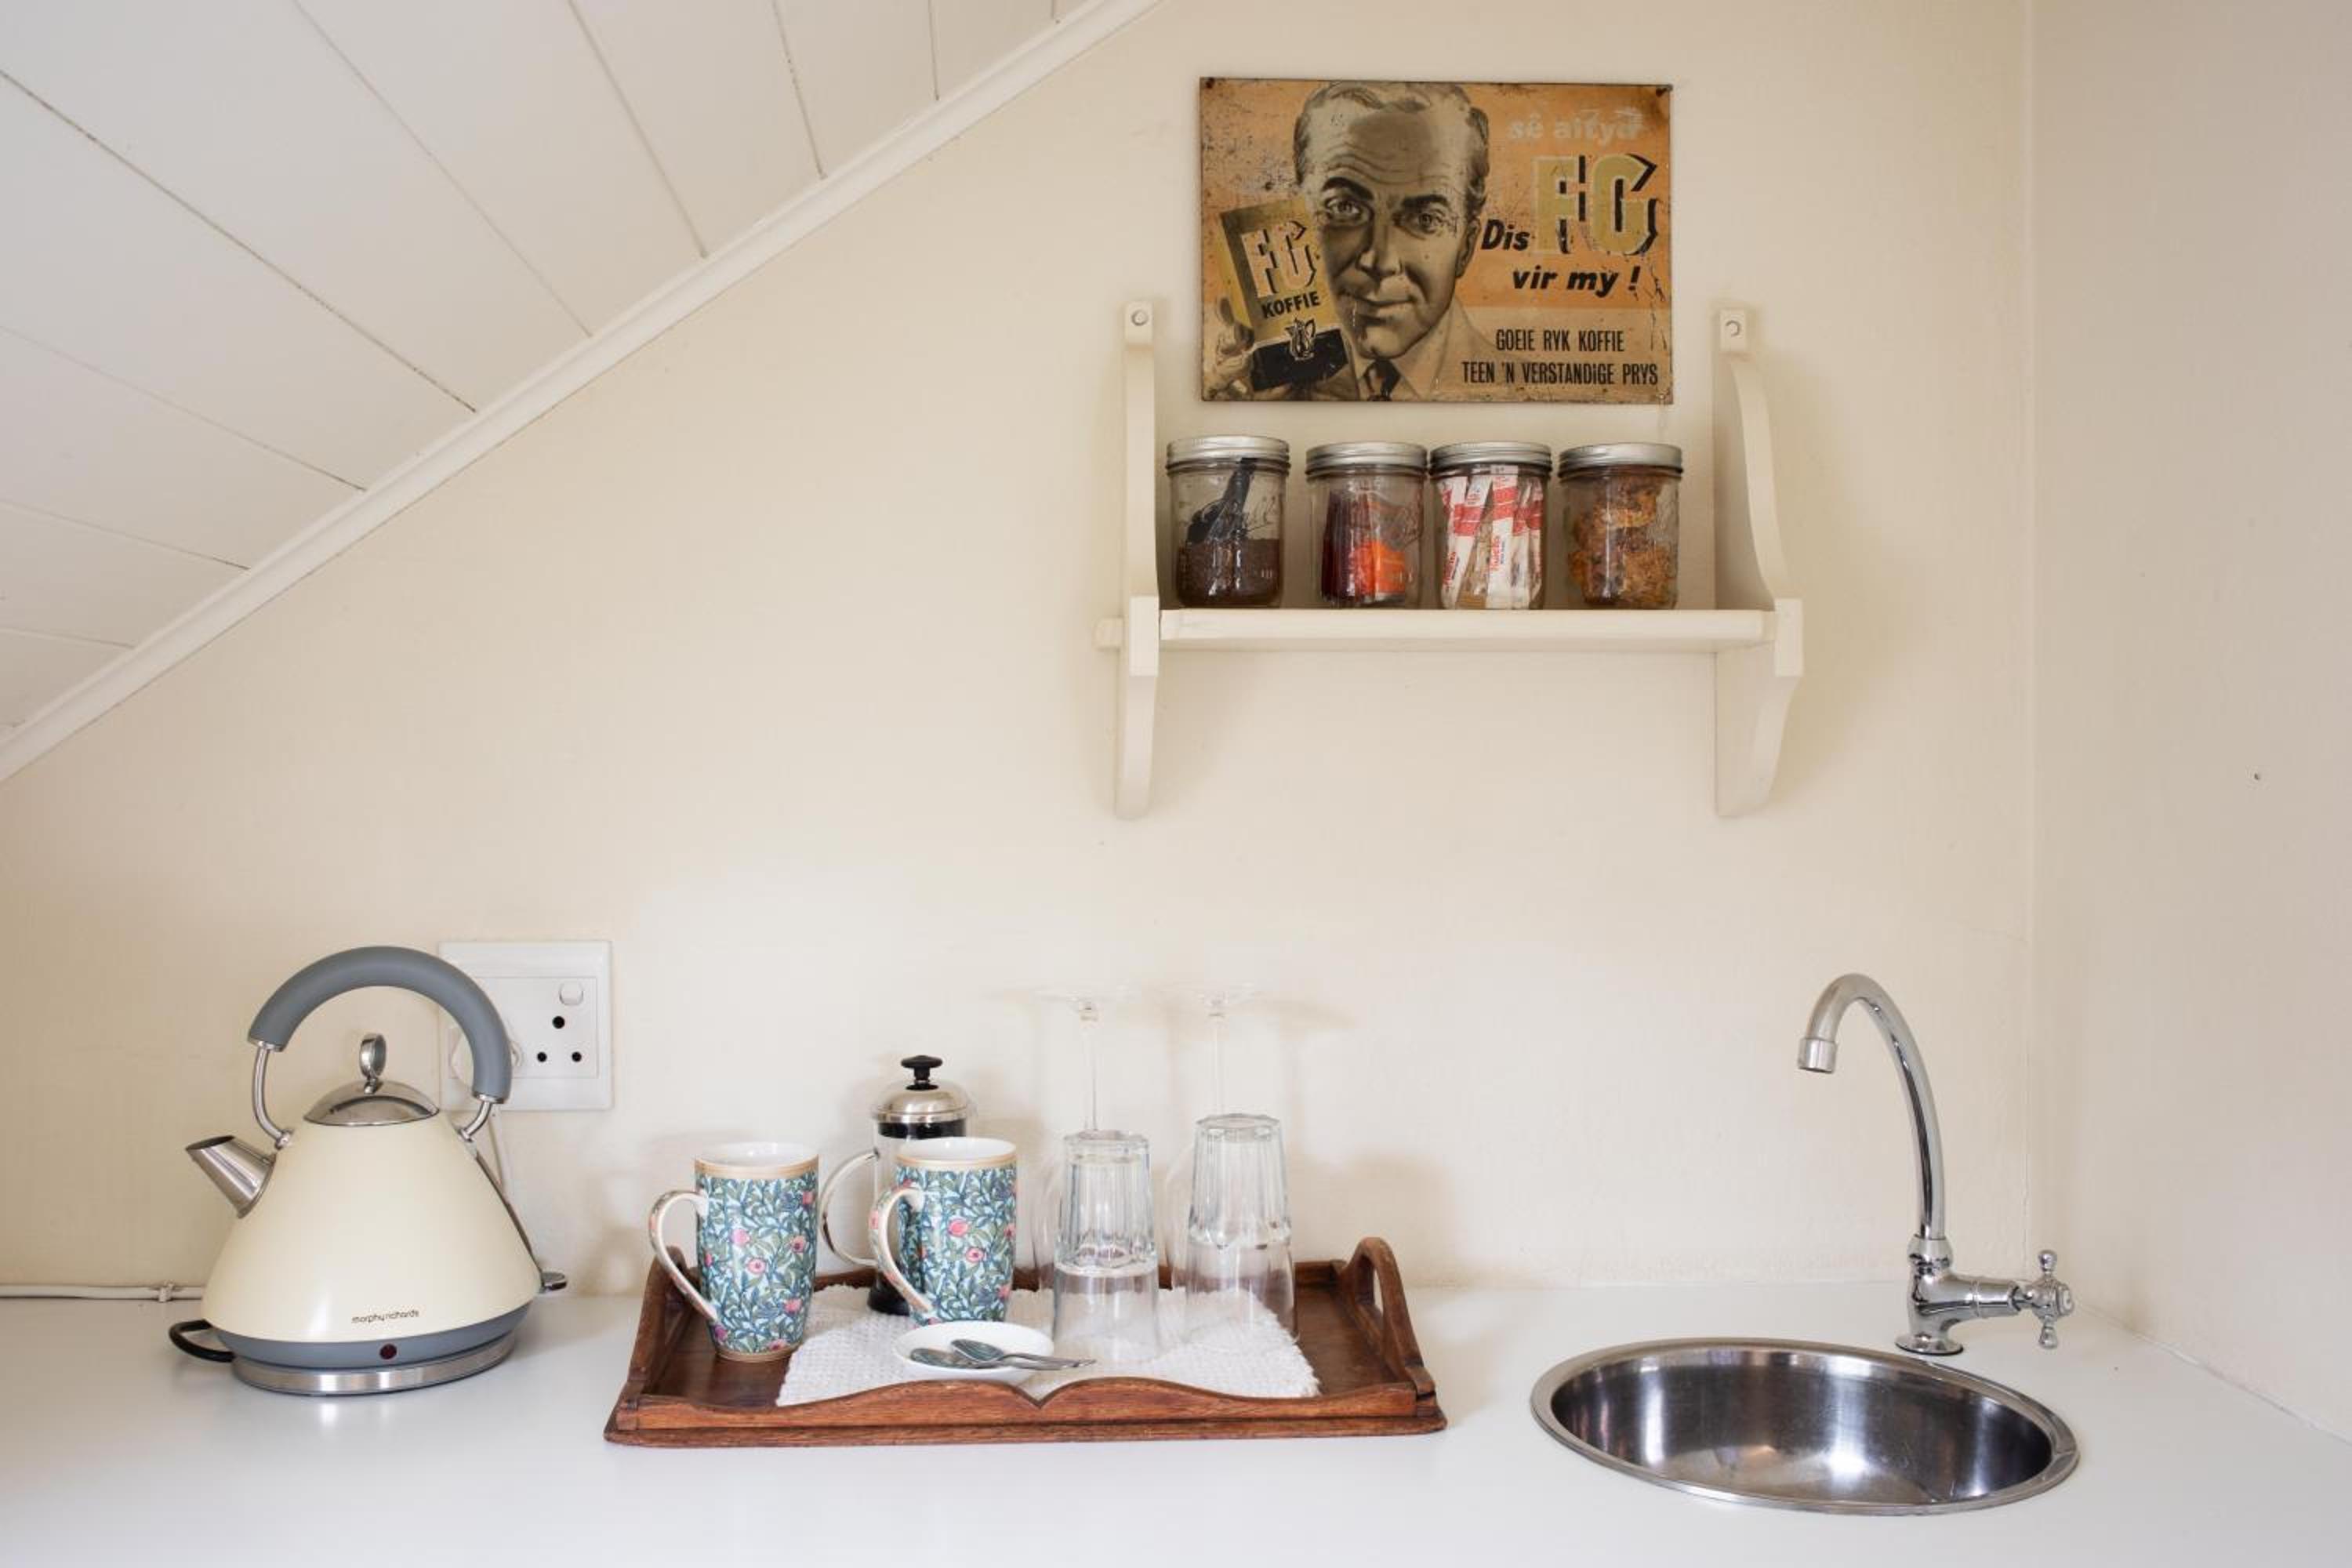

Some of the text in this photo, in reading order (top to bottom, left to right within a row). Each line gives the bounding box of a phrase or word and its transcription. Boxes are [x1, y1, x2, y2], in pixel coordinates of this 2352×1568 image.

[1481, 153, 1657, 256] Dis FG
[1512, 265, 1558, 289] vir
[1261, 291, 1320, 319] KOFFIE
[1496, 329, 1624, 351] GOEIE RYK KOFFIE
[1462, 361, 1495, 383] TEEN
[1622, 364, 1658, 385] PRYS
